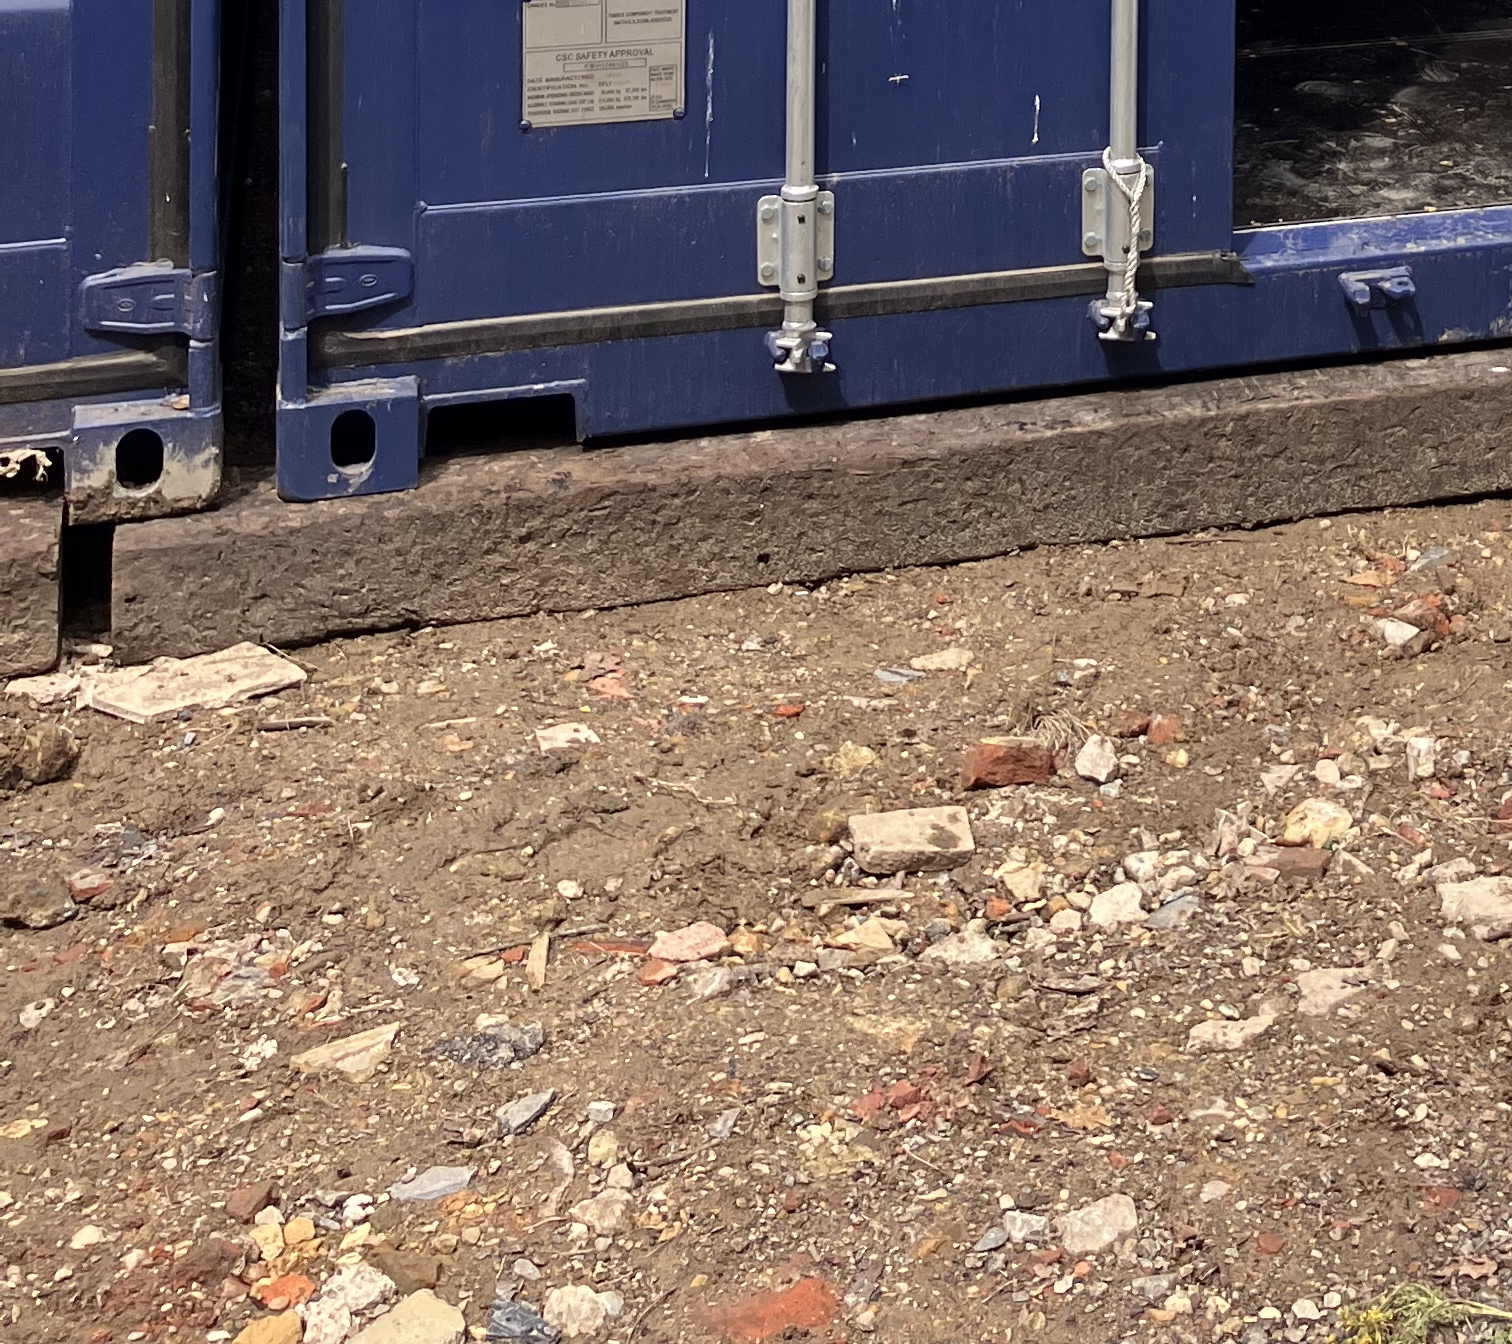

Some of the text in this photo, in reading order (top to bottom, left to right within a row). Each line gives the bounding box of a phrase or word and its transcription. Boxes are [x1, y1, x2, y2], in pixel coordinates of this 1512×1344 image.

[555, 47, 655, 62] CSC SAFETY APPROVAL
